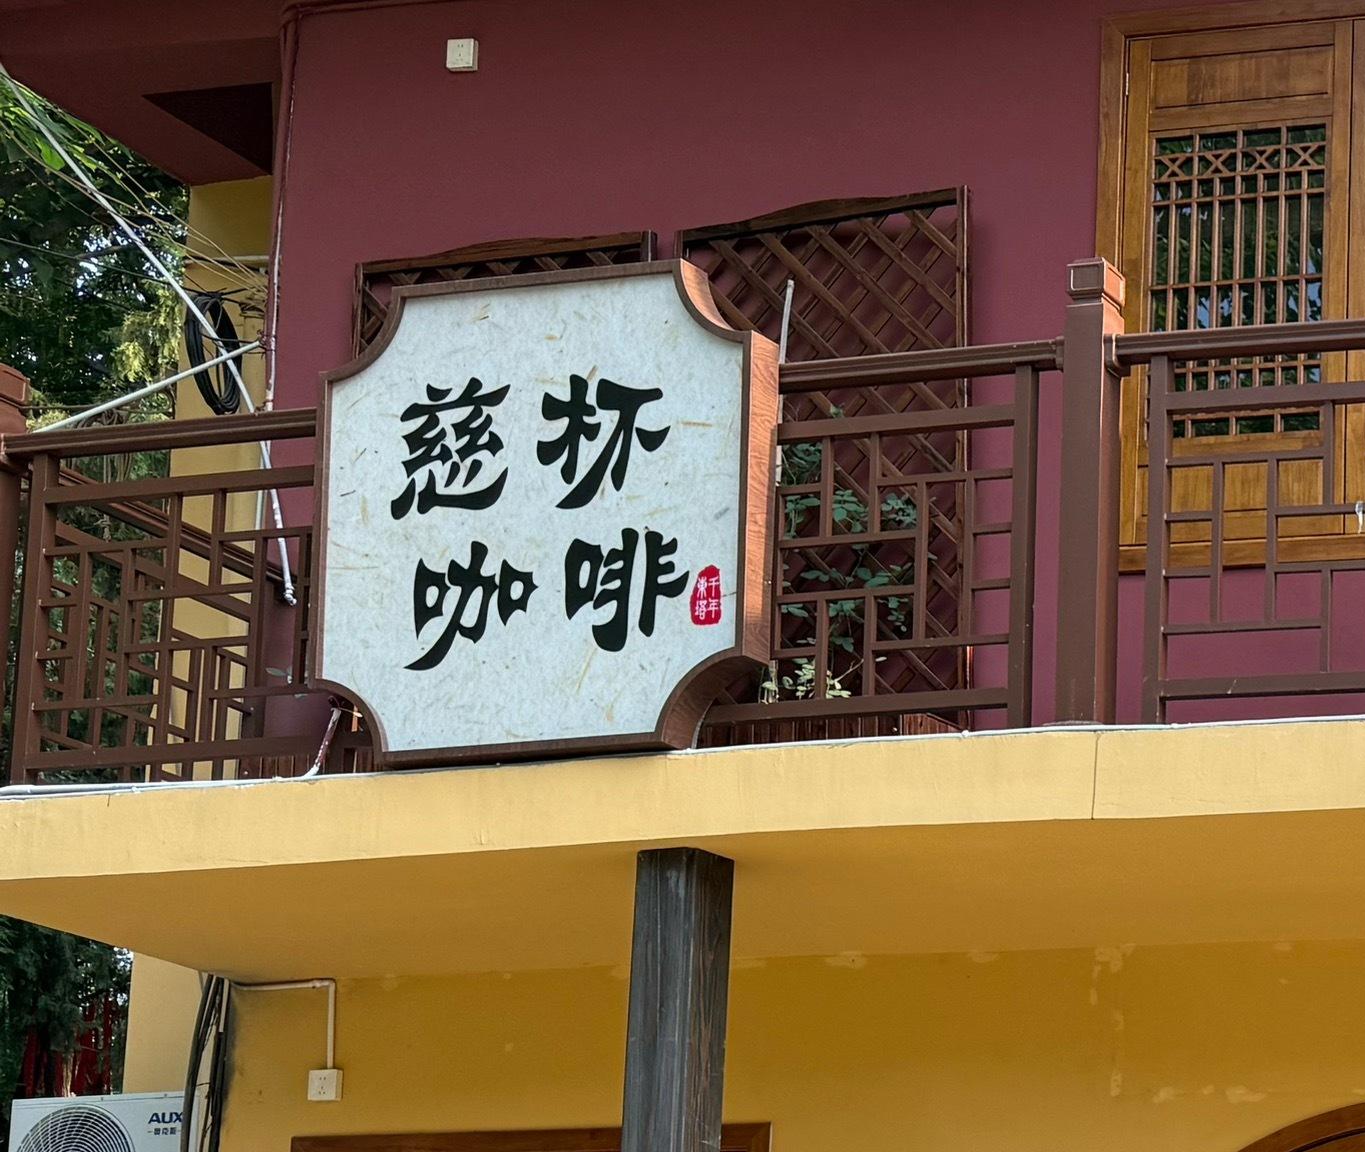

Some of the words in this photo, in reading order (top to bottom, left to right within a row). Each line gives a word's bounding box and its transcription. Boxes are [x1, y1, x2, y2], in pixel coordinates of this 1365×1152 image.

[391, 374, 671, 520] 慈杯
[404, 527, 690, 672] 咖啡
[148, 1111, 183, 1125] AUX
